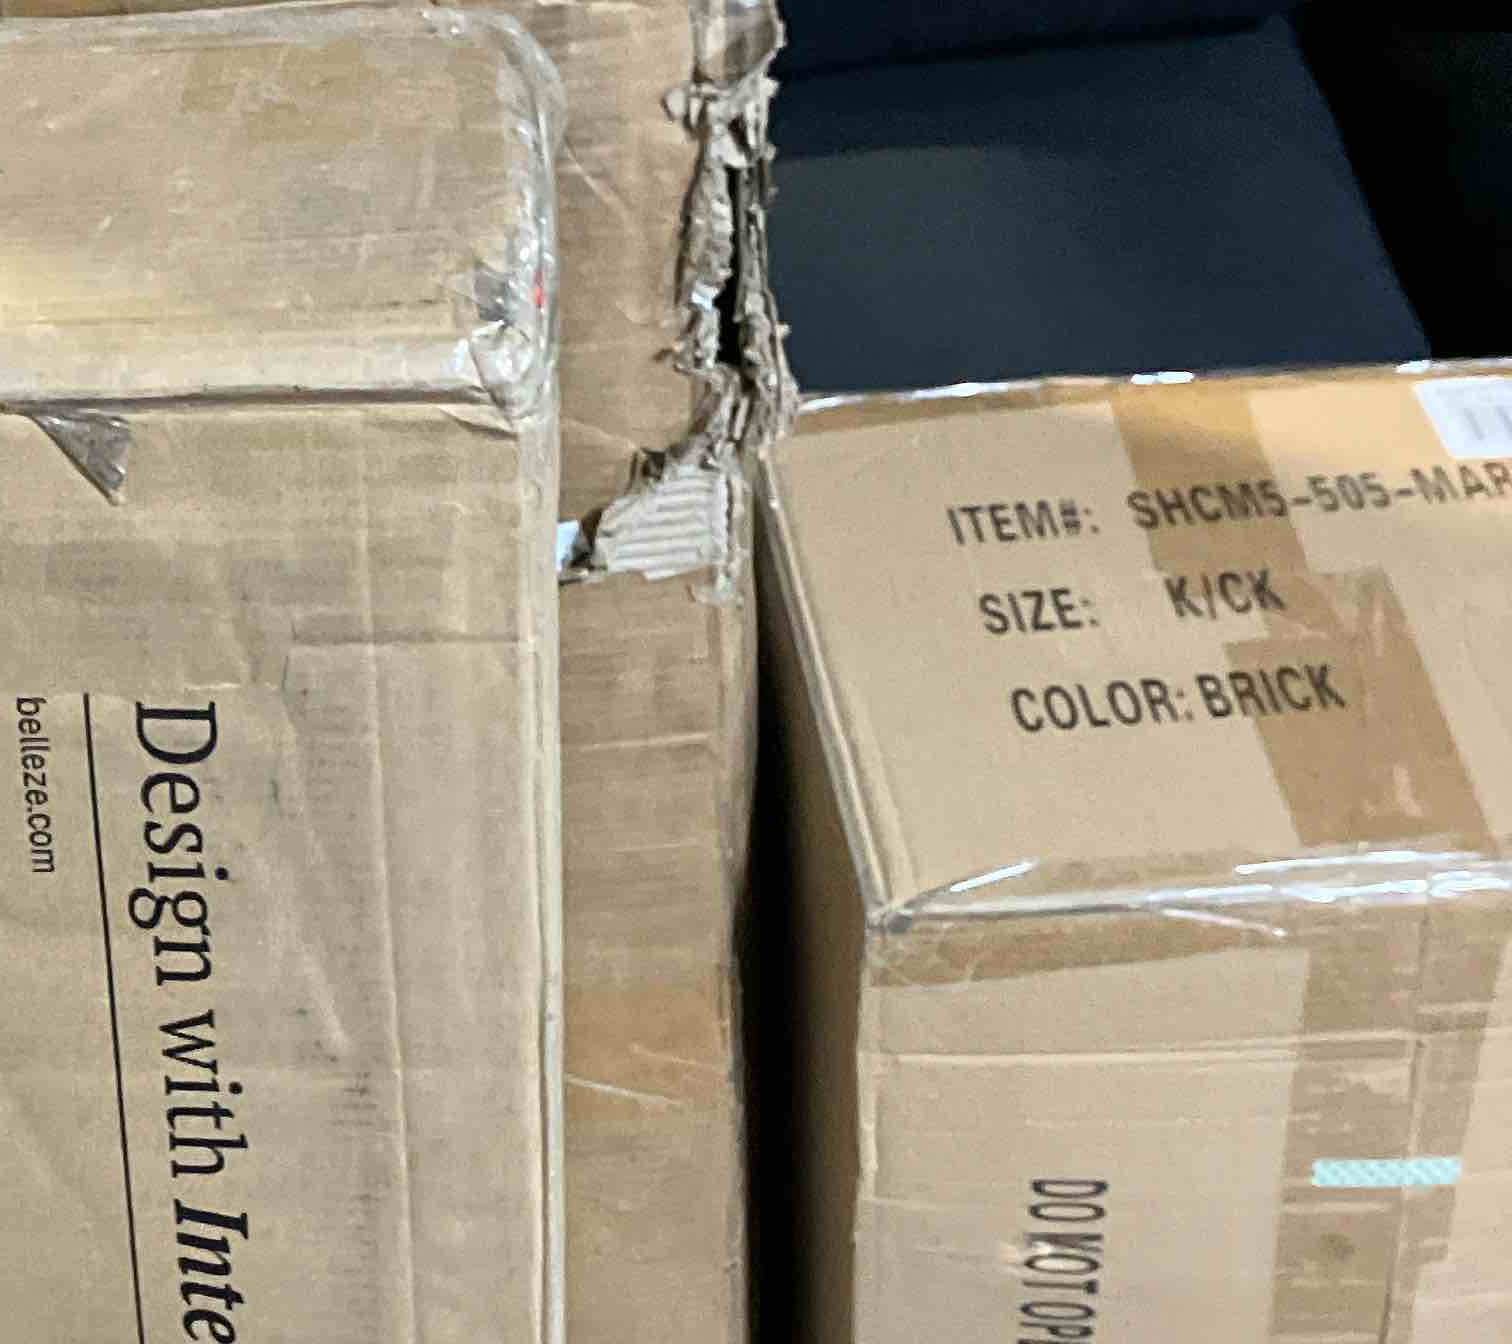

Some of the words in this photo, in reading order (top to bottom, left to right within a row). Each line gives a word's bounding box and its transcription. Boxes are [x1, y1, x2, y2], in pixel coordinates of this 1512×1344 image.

[946, 498, 1100, 546] ITEM#:
[978, 586, 1101, 635] SIZE:
[1164, 567, 1285, 621] K/CK
[1010, 677, 1194, 734] COLOR:
[1195, 662, 1347, 719] BRICK
[16, 696, 56, 875] belleze.com
[128, 700, 230, 987] Design
[158, 1008, 249, 1179] with
[1027, 1179, 1110, 1223] DO
[1022, 1232, 1105, 1295] NOT
